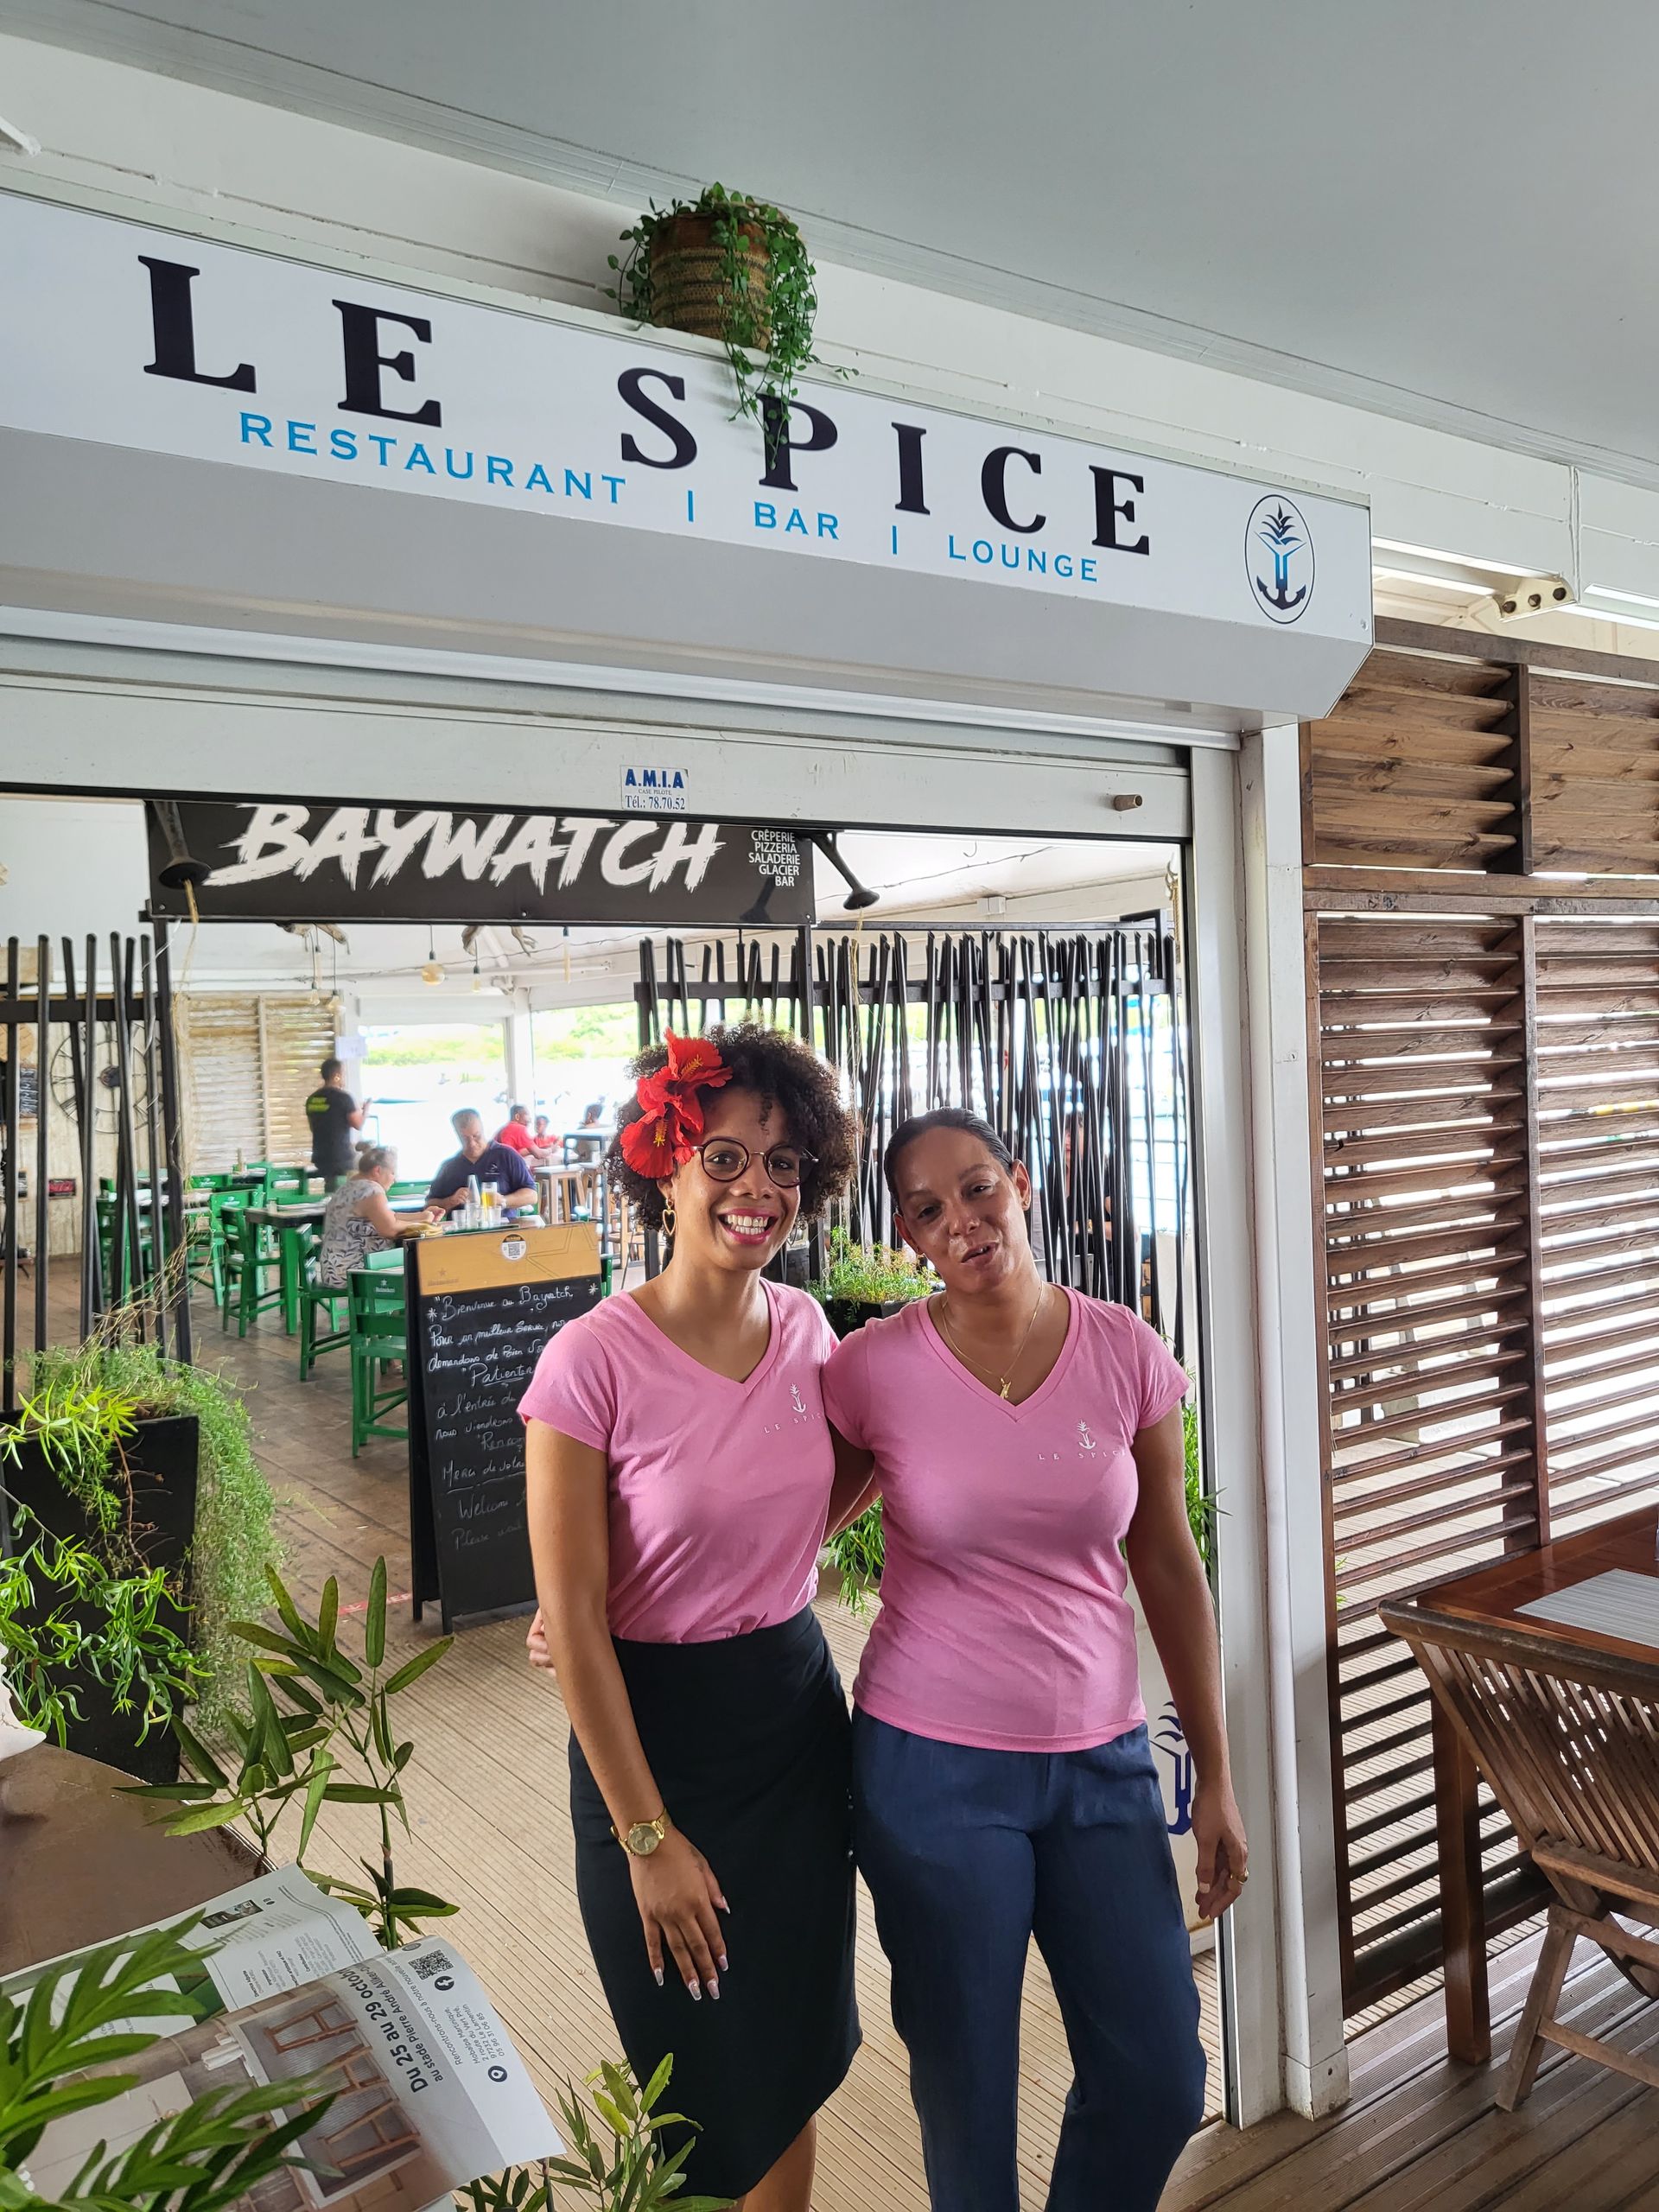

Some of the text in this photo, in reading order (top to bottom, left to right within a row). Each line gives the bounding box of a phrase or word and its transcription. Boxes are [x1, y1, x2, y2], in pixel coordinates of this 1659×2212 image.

[138, 255, 1150, 556] LE SPICE
[239, 412, 1098, 583] RESTAURANT BAR LOUNGE
[625, 769, 684, 789] A.M.I.A
[625, 794, 685, 810] Tél.: 78.70.52
[751, 829, 796, 842] CRÊPERIE
[202, 804, 728, 896] BAYWATCH
[754, 842, 798, 854] PIZZERIA
[748, 852, 801, 865] SALADERIE
[759, 864, 800, 876] GLACIER
[774, 875, 795, 887] BAR
[379, 1988, 404, 2013] André
[365, 2001, 388, 2021] 29
[380, 2021, 400, 2042] au
[398, 2014, 420, 2043] Pierre
[390, 2044, 414, 2067] 25
[415, 2043, 436, 2069] stade
[406, 2067, 429, 2093] Du
[430, 2069, 444, 2082] au
